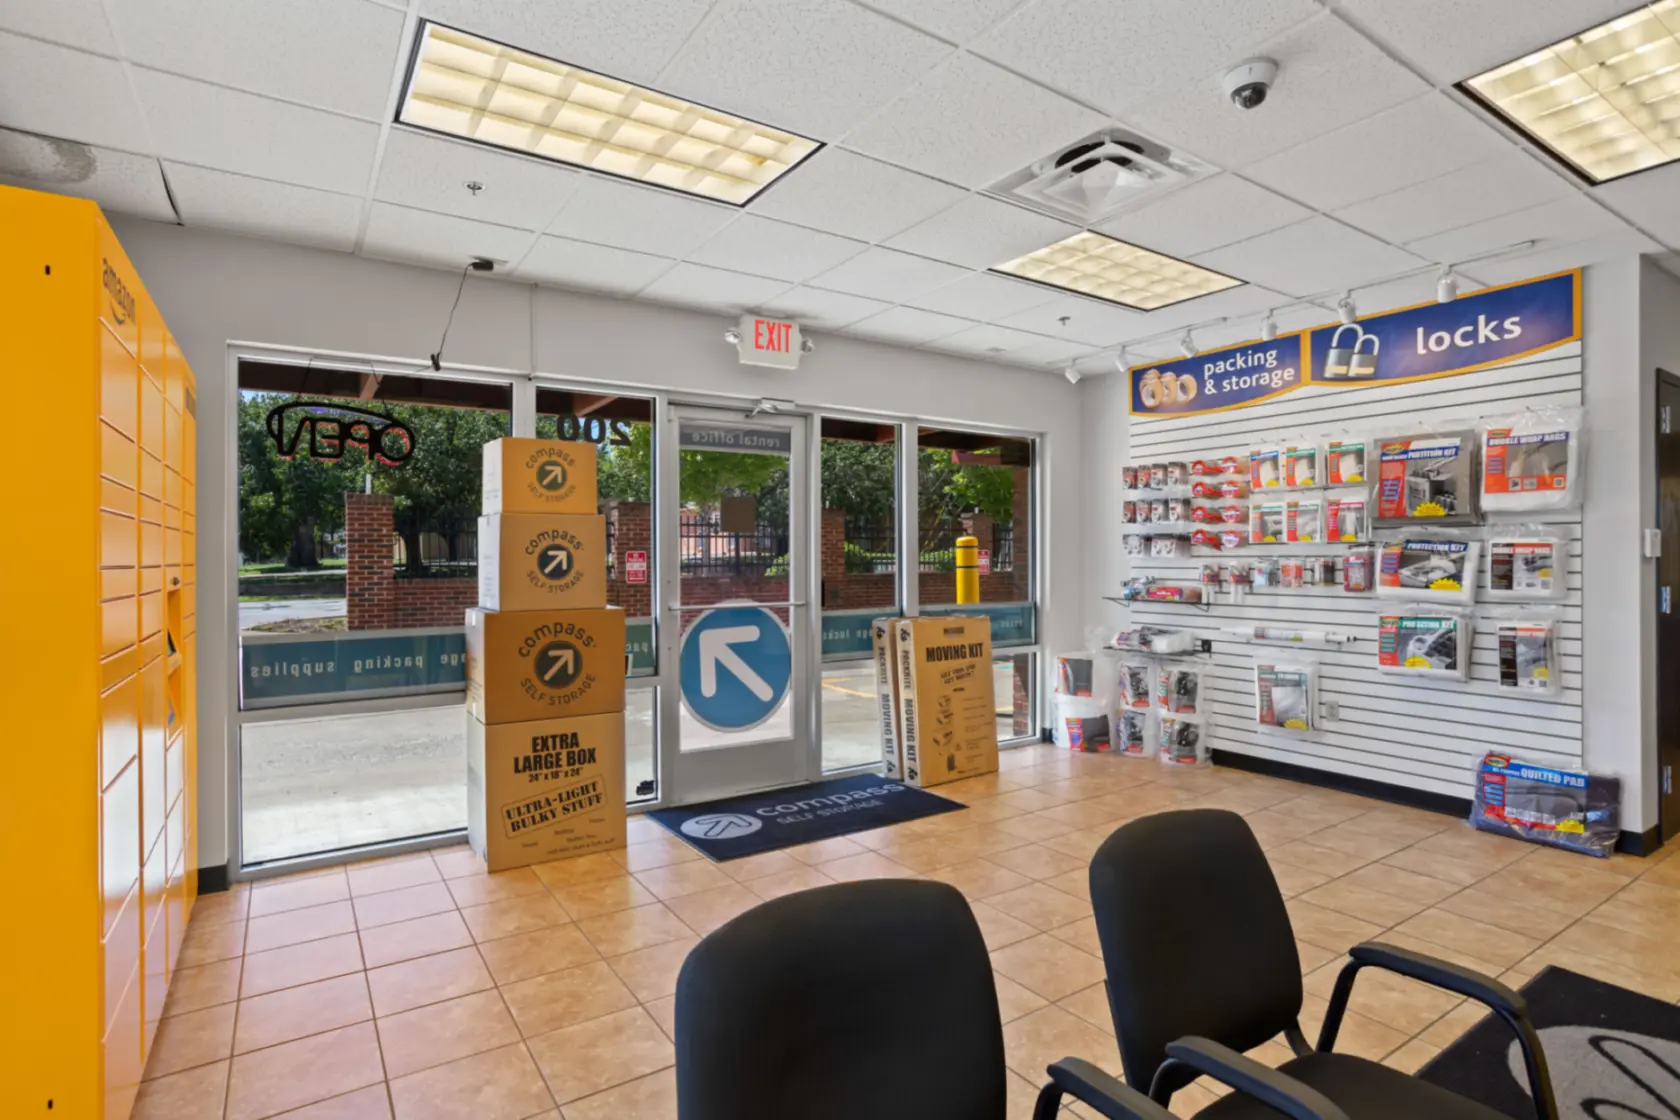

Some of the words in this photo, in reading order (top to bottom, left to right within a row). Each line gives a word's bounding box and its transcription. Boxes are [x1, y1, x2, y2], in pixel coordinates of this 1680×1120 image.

[102, 258, 136, 322] amazon
[754, 319, 793, 353] EXIT
[1416, 314, 1523, 355] locks
[1204, 347, 1278, 380] packing
[1204, 378, 1218, 395] &
[1222, 367, 1296, 393] storage
[525, 447, 576, 470] compass
[527, 481, 544, 499] SELF
[525, 529, 584, 556] compass
[527, 570, 545, 591] SELF
[547, 569, 584, 594] STORAGE
[518, 621, 596, 658] compass
[926, 646, 967, 664] MOVING
[969, 642, 984, 659] KIT
[521, 677, 545, 703] SELF
[549, 673, 597, 706] STORAGE
[881, 693, 892, 736] MOVING
[904, 698, 915, 743] MOVING
[532, 732, 580, 753] EXTRA
[886, 738, 894, 755] KIT
[907, 745, 917, 763] KIT
[513, 752, 562, 774] LARGE
[567, 747, 597, 767] BOX
[1520, 767, 1561, 784] QUILTED
[1563, 774, 1585, 788] PAD
[505, 780, 599, 821] ULTRA-LIGHT
[511, 807, 558, 833] BULKY
[561, 792, 604, 817] STUFF
[756, 782, 906, 817] compass
[775, 811, 814, 826] SELF
[817, 799, 884, 818] STORAGE
